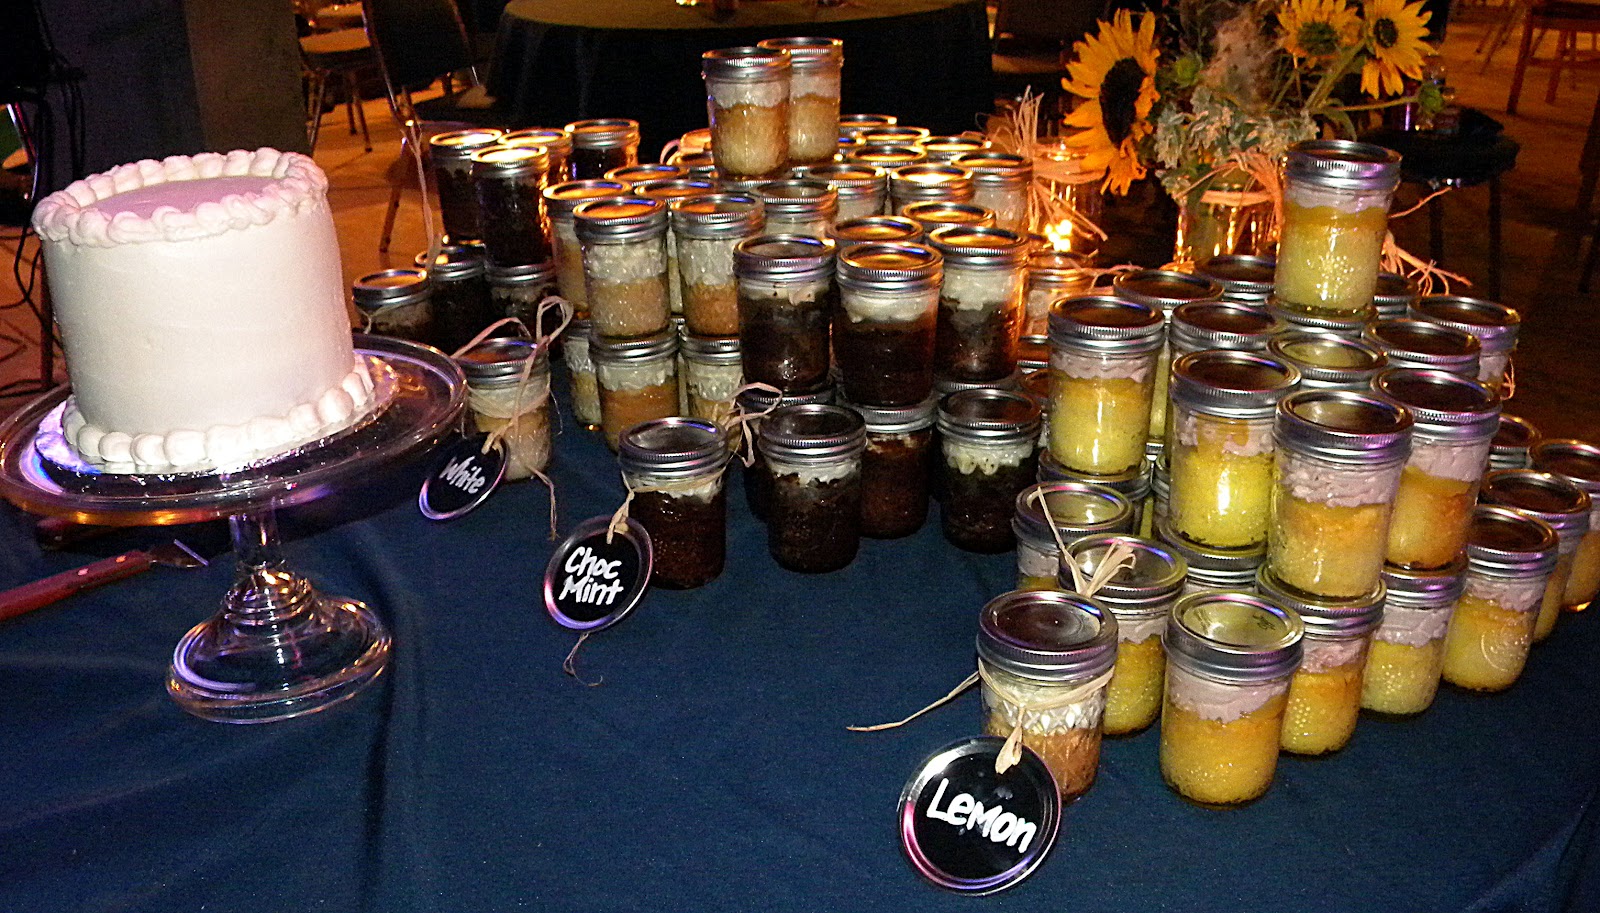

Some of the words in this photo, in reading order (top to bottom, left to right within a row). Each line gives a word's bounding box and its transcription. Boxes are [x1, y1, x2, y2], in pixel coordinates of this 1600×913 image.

[439, 456, 486, 494] White
[565, 546, 622, 579] Choc
[558, 575, 624, 605] Mint
